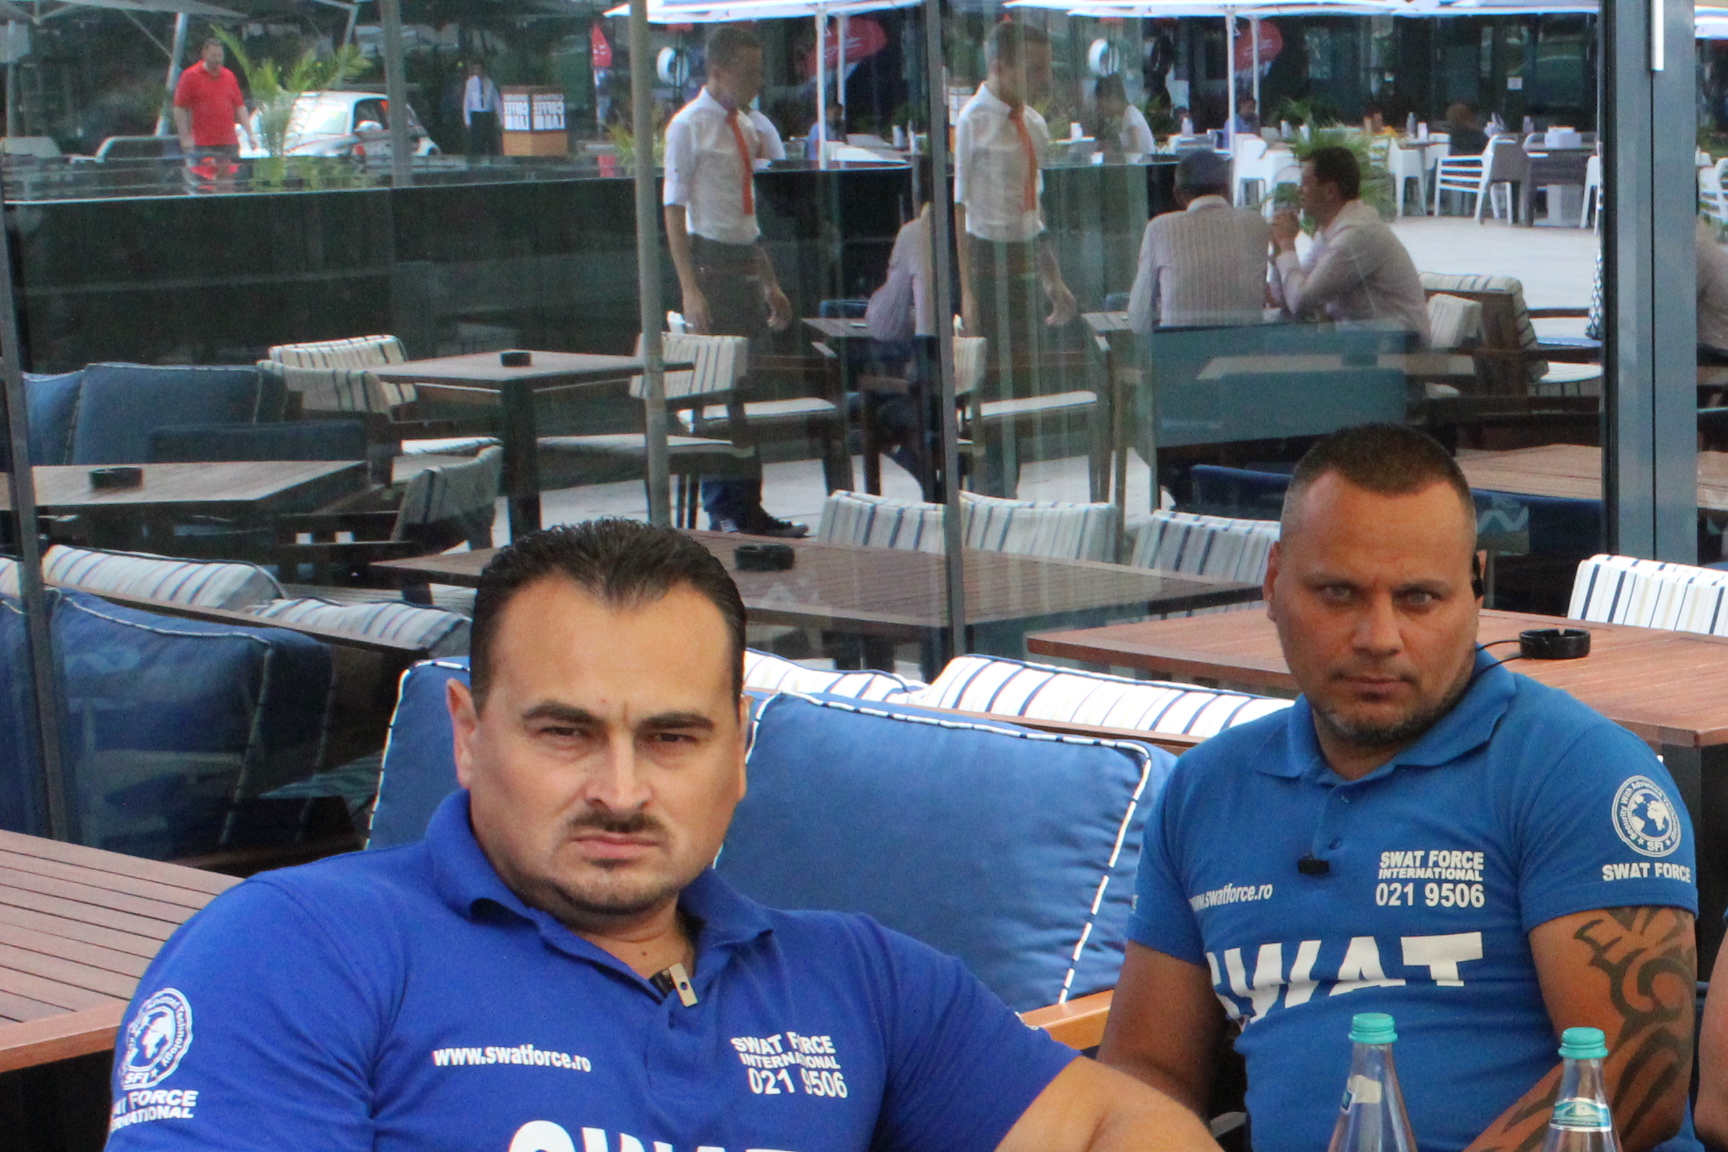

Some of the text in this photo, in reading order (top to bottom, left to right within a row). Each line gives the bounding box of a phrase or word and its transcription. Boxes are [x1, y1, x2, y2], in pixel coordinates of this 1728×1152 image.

[1646, 841, 1664, 852] SFI
[1379, 850, 1485, 870] SWAT FORCE
[1378, 867, 1484, 882] INTERNATIONAL
[1601, 862, 1692, 884] SWAT FORCE
[1375, 882, 1486, 908] 021 9506
[730, 1031, 837, 1055] SWAT FRCE
[432, 1043, 592, 1073] www.swatforce.ro
[124, 1072, 150, 1085] SFI
[748, 1067, 848, 1099] 021 9506
[127, 1089, 199, 1109] FORCE
